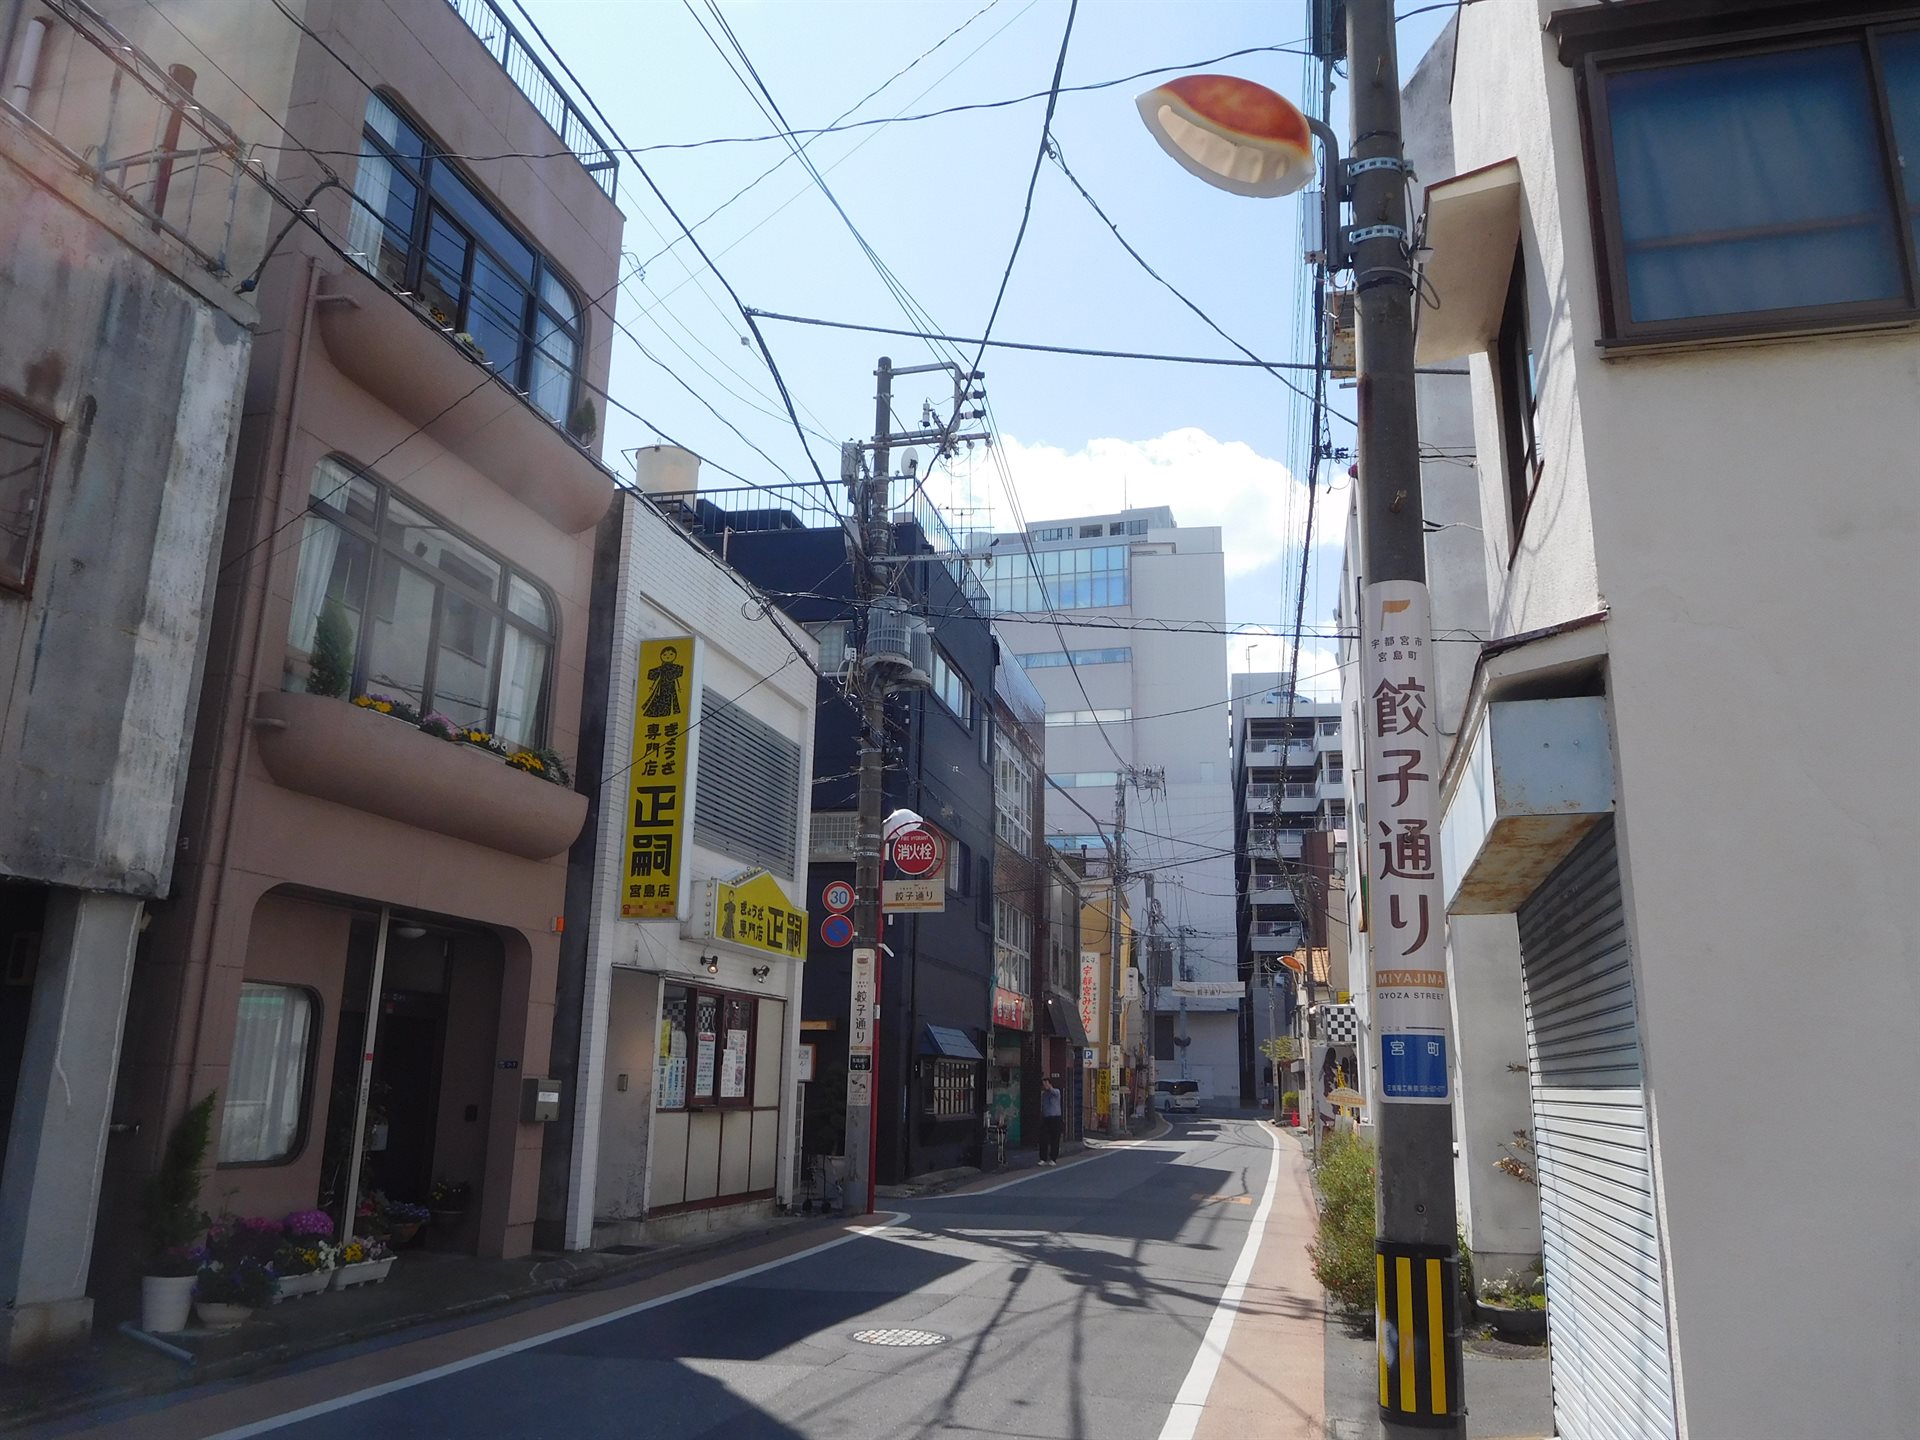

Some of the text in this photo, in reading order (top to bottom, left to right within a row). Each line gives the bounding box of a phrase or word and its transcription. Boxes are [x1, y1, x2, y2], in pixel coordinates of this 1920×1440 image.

[1371, 635, 1422, 649] 宇都宮市
[1378, 650, 1417, 662] 宮島町
[641, 723, 662, 776] 専門店
[661, 721, 679, 776] ぎょうざ
[1372, 676, 1434, 956] 餃子通り
[630, 785, 676, 878] 正嗣
[897, 843, 933, 860] 消火栓
[629, 884, 670, 898] 宮島店
[830, 890, 848, 905] 30
[740, 900, 764, 921] ぎょうざ
[739, 919, 763, 942] 専門店
[766, 905, 803, 955] 正嗣
[1378, 973, 1443, 985] MIYAJIMA
[1082, 965, 1093, 1034] 宇都宮みんみん
[1379, 992, 1444, 1001] GYOZA STREET
[855, 990, 868, 1044] 餃子通り
